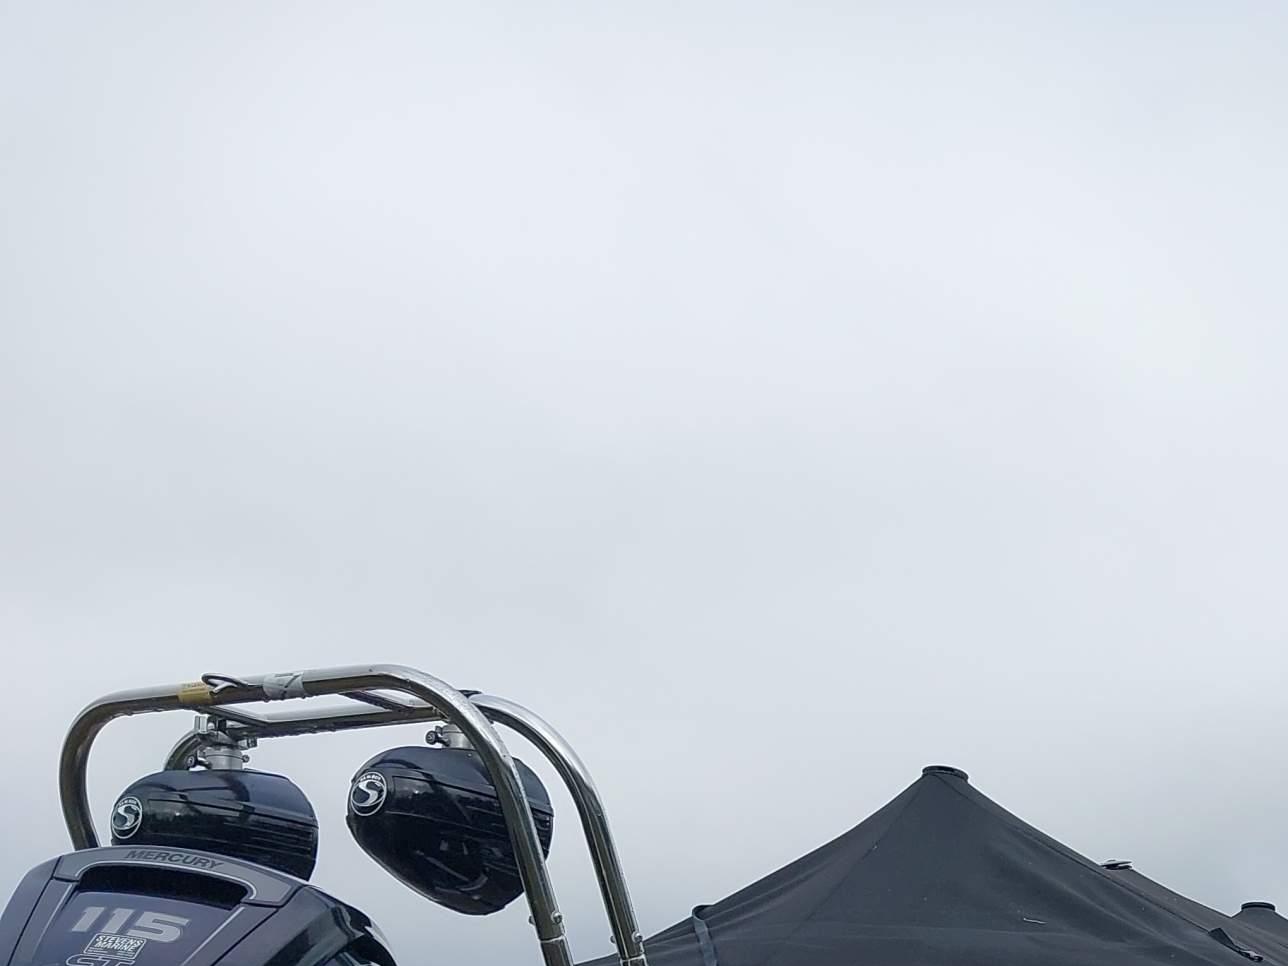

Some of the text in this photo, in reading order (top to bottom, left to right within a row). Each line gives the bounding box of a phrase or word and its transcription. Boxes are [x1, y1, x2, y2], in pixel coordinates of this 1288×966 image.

[124, 850, 224, 869] MERCURY
[72, 906, 191, 943] 115
[94, 941, 138, 952] MARINE
[97, 935, 144, 948] STEVENS
